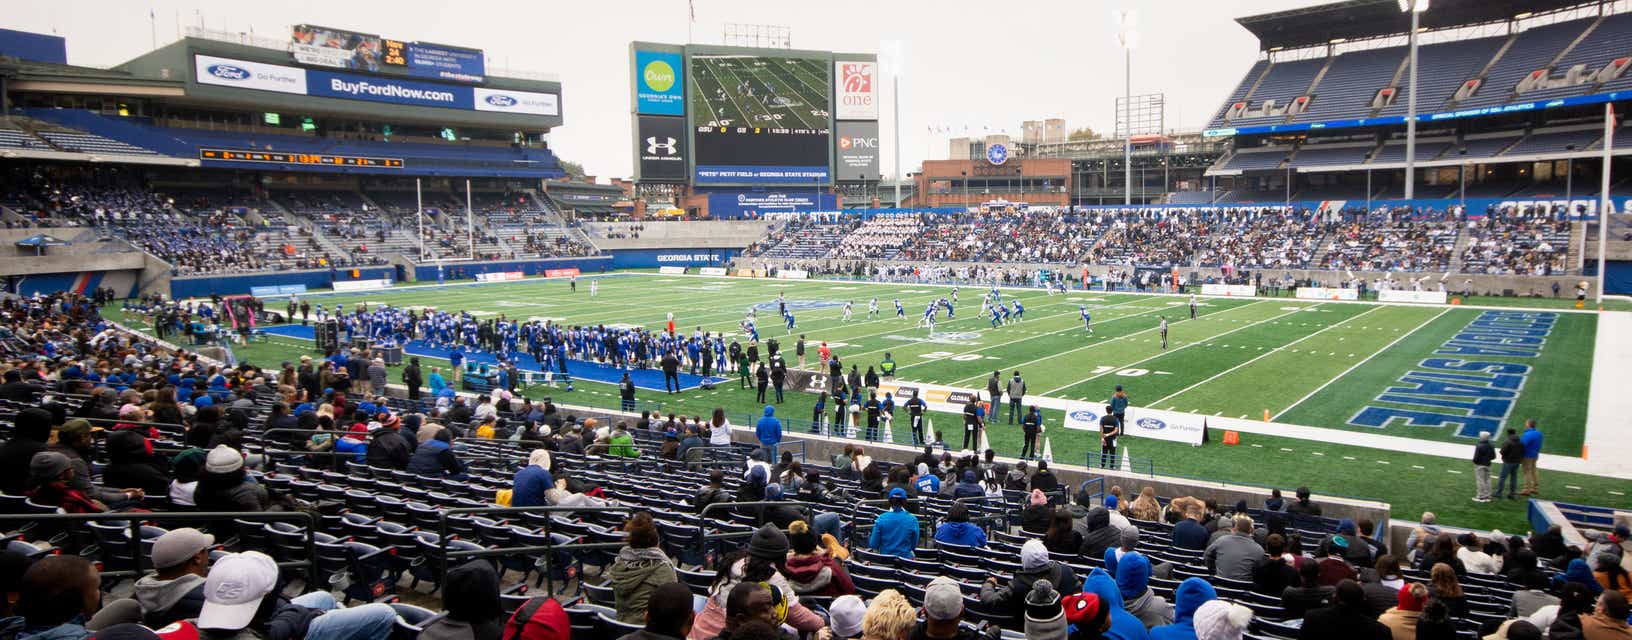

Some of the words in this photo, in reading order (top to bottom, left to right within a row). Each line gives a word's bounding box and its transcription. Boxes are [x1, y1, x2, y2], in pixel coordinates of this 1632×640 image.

[212, 64, 246, 80] Ford
[257, 72, 269, 80] Go
[270, 74, 296, 83] Further
[645, 69, 673, 82] Own
[331, 79, 454, 102] BuyFordNow.com
[843, 95, 872, 105] one
[853, 137, 878, 148] PNC
[657, 254, 692, 262] GEORGIA
[693, 254, 720, 262] STATE
[1432, 310, 1561, 358] GEORGIA
[1346, 357, 1533, 442] STATE
